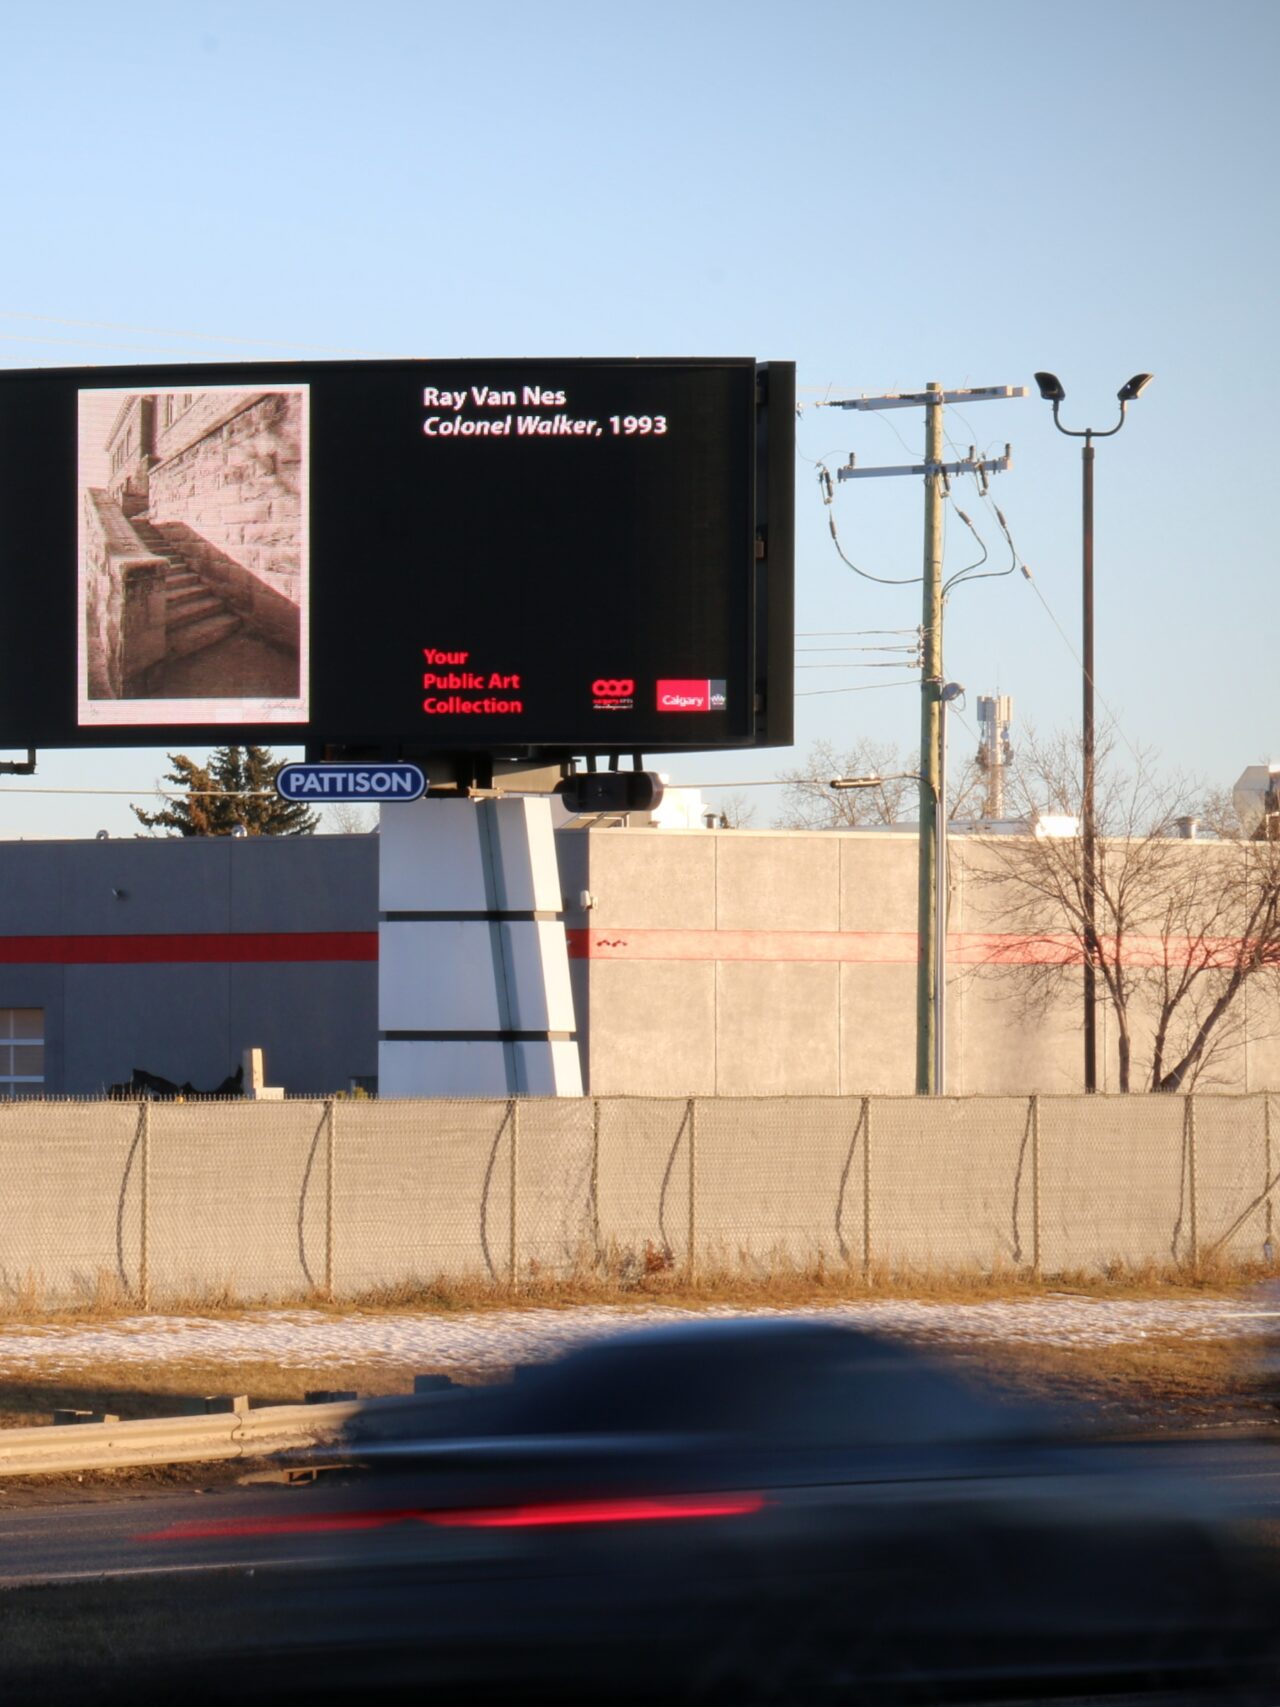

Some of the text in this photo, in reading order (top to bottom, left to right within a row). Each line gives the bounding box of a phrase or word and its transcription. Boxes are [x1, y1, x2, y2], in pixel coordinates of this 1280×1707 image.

[423, 385, 567, 411] Ray Van Nes
[423, 414, 668, 437] Colonel Walker, 1993
[423, 648, 469, 665] Your
[423, 672, 521, 690] Public Art
[423, 696, 523, 715] Collection
[662, 694, 705, 708] Calgary
[289, 771, 412, 793] PATTISON
